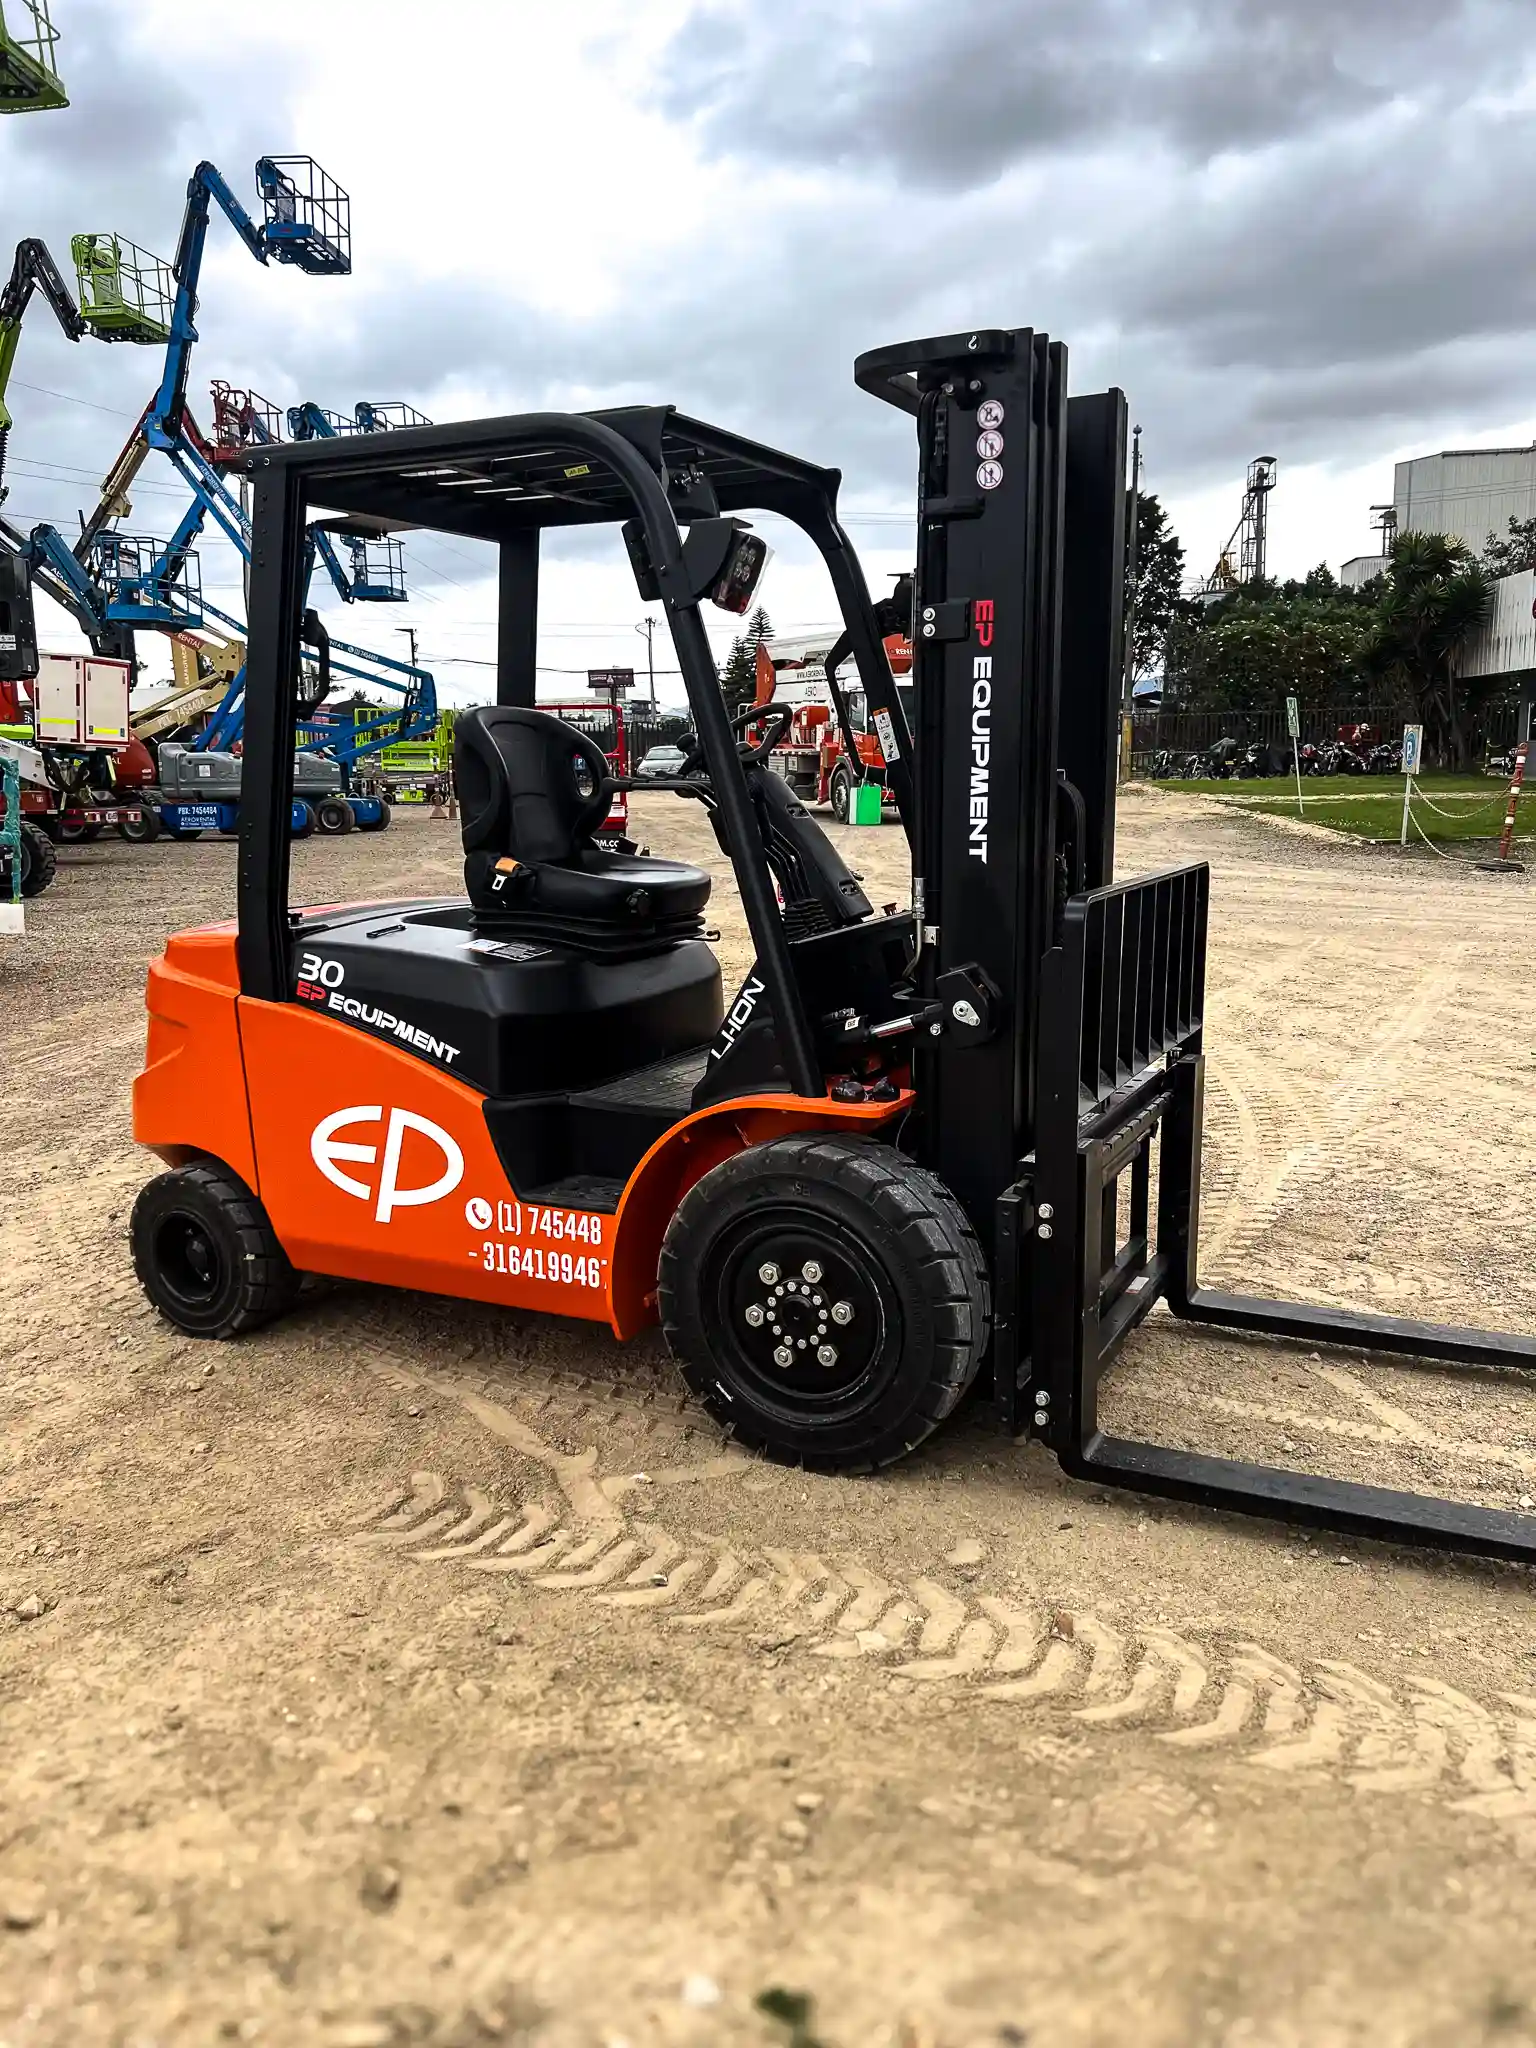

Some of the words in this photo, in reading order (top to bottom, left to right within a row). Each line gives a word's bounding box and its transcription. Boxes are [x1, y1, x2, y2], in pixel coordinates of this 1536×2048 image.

[975, 600, 994, 646] EP
[969, 656, 993, 865] EQUIPMENT
[192, 806, 218, 815] 7454484
[298, 952, 345, 988] 30
[296, 980, 327, 1001] EP
[328, 991, 461, 1064] EQUIPMENT
[710, 976, 766, 1060] LI-ION
[310, 1105, 465, 1224] EP
[497, 1200, 521, 1236] (1)
[528, 1207, 602, 1245] 745448
